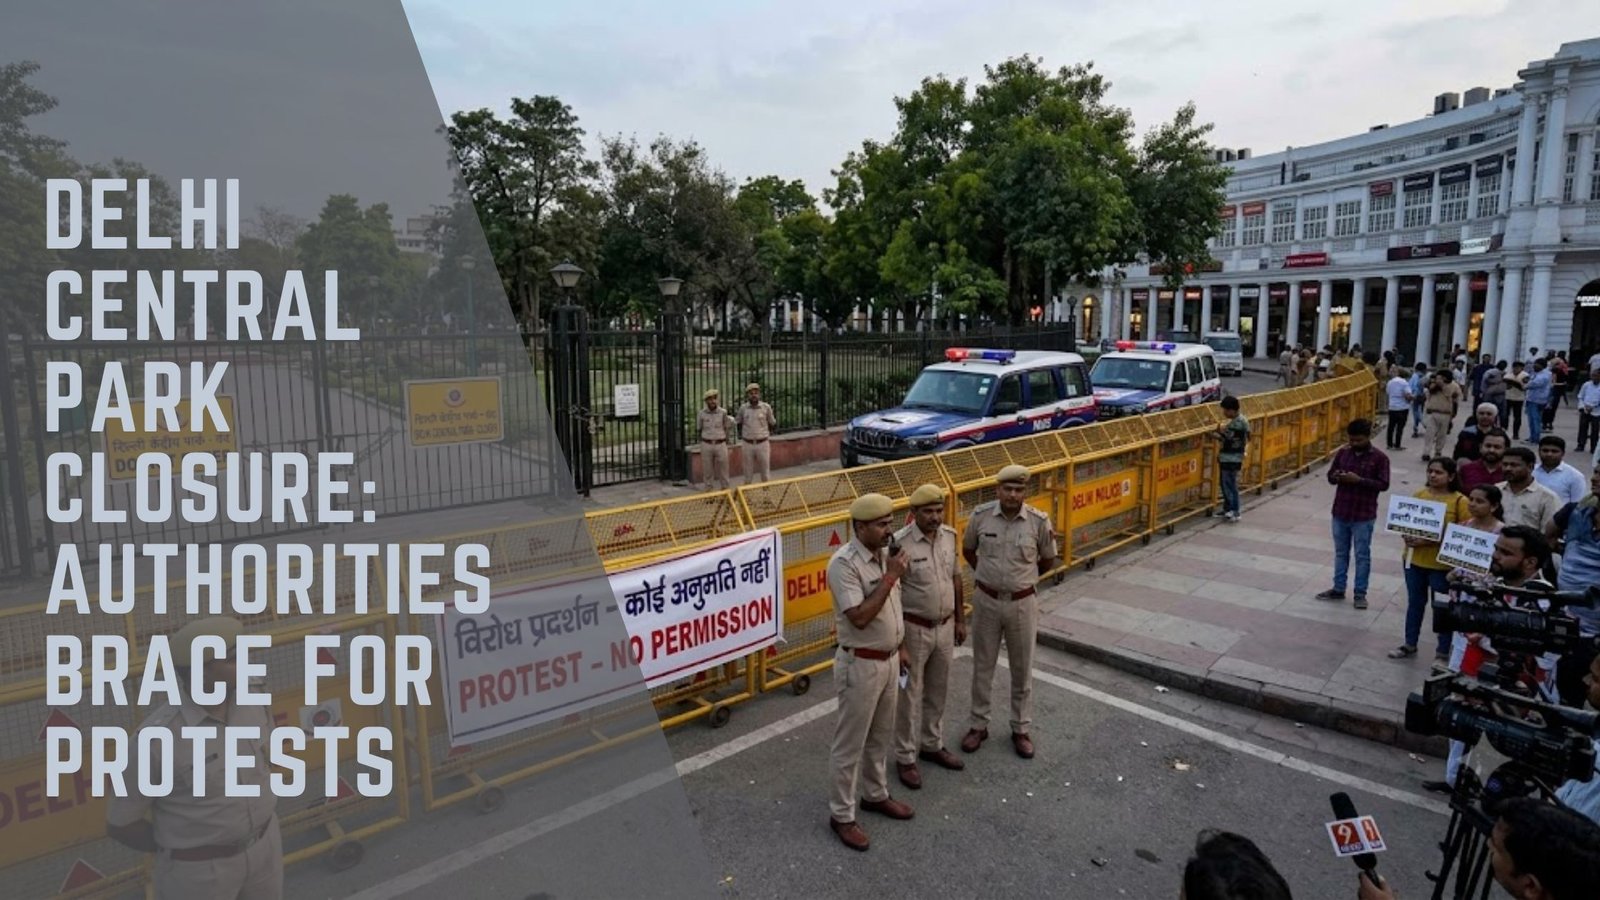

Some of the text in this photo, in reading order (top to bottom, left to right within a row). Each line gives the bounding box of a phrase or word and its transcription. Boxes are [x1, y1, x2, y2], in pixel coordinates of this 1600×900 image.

[454, 614, 523, 659] विरोध
[528, 594, 600, 647] प्रदर्शन
[624, 574, 666, 617] कोई
[671, 558, 737, 611] अनुमति
[740, 547, 772, 584] नहीं
[787, 569, 827, 602] DELH
[459, 651, 583, 713] PROTEST
[610, 635, 644, 672] NO
[651, 595, 773, 660] PERMISSION
